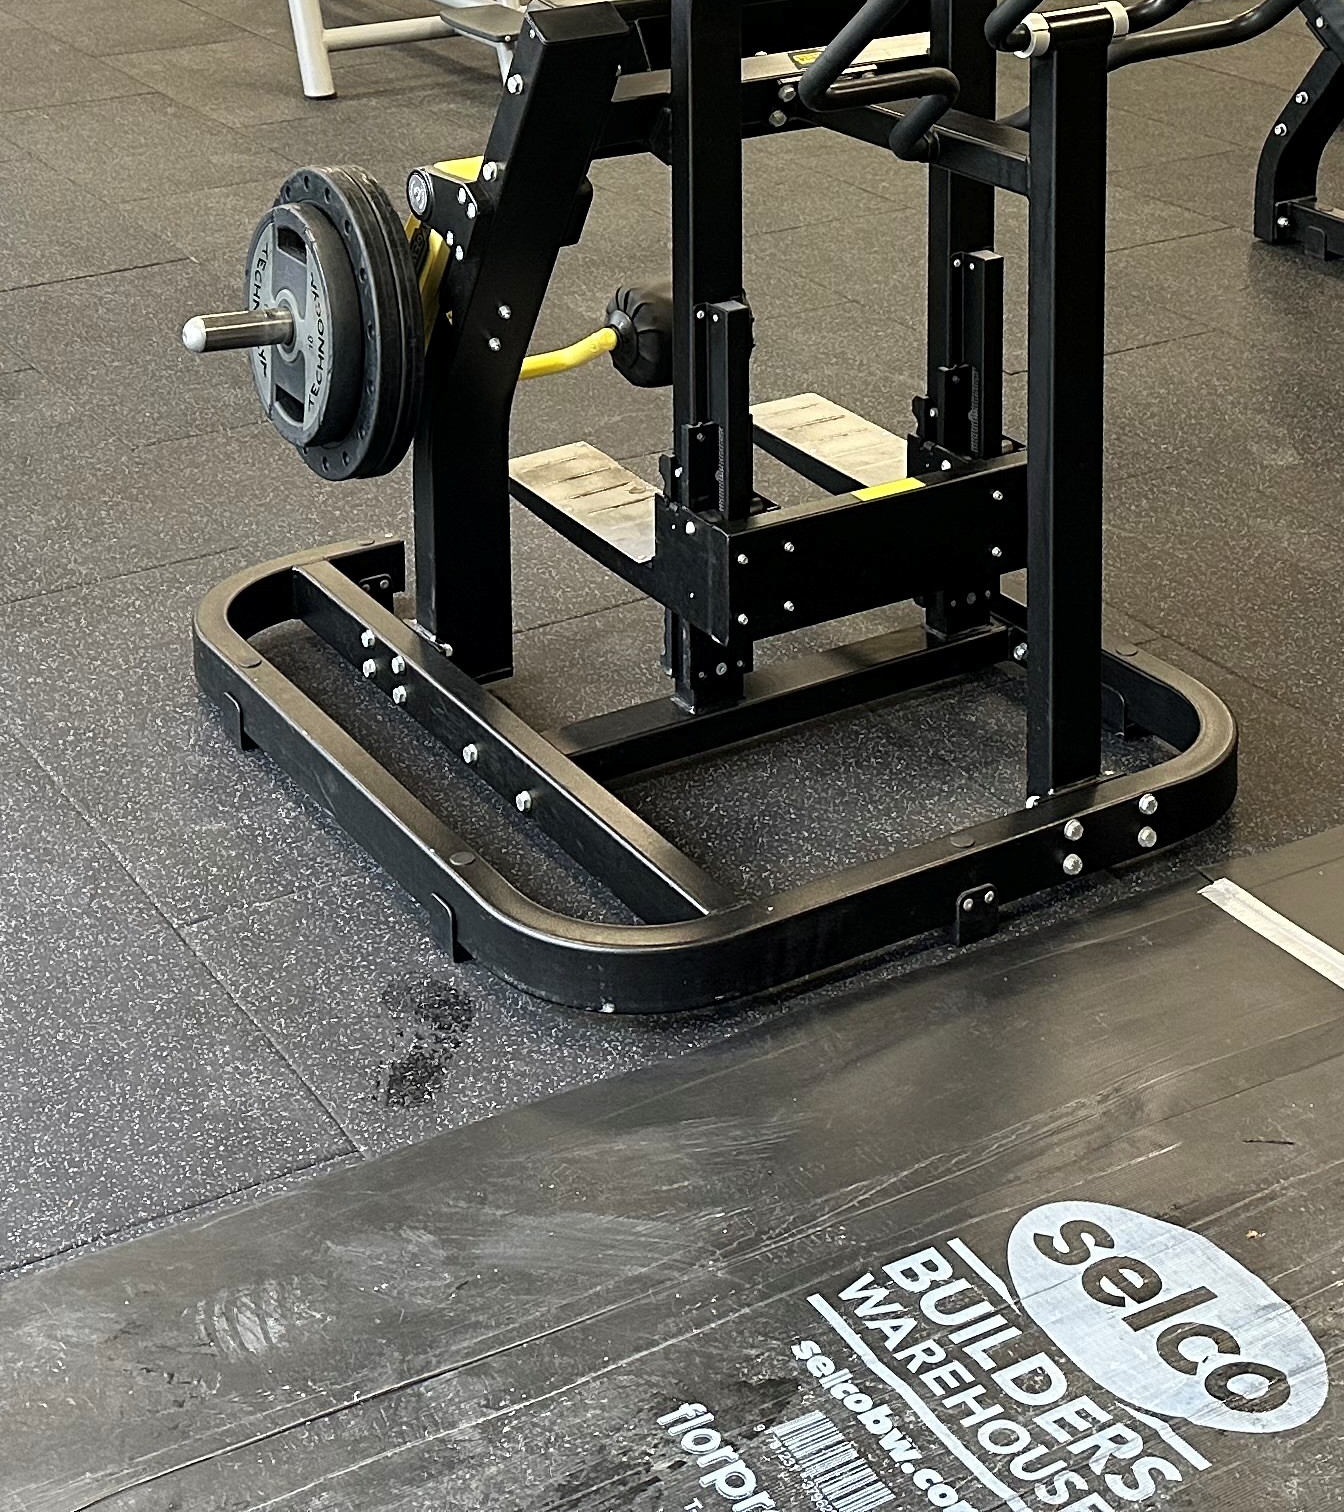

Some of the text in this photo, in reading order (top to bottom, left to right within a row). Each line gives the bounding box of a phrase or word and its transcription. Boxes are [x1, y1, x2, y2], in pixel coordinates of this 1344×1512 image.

[307, 272, 326, 413] TECHNOGYM
[880, 1245, 1184, 1502] BUILDERS
[1032, 1219, 1292, 1414] selco
[656, 1401, 777, 1512] florpr
[790, 1339, 979, 1512] selcobw.co
